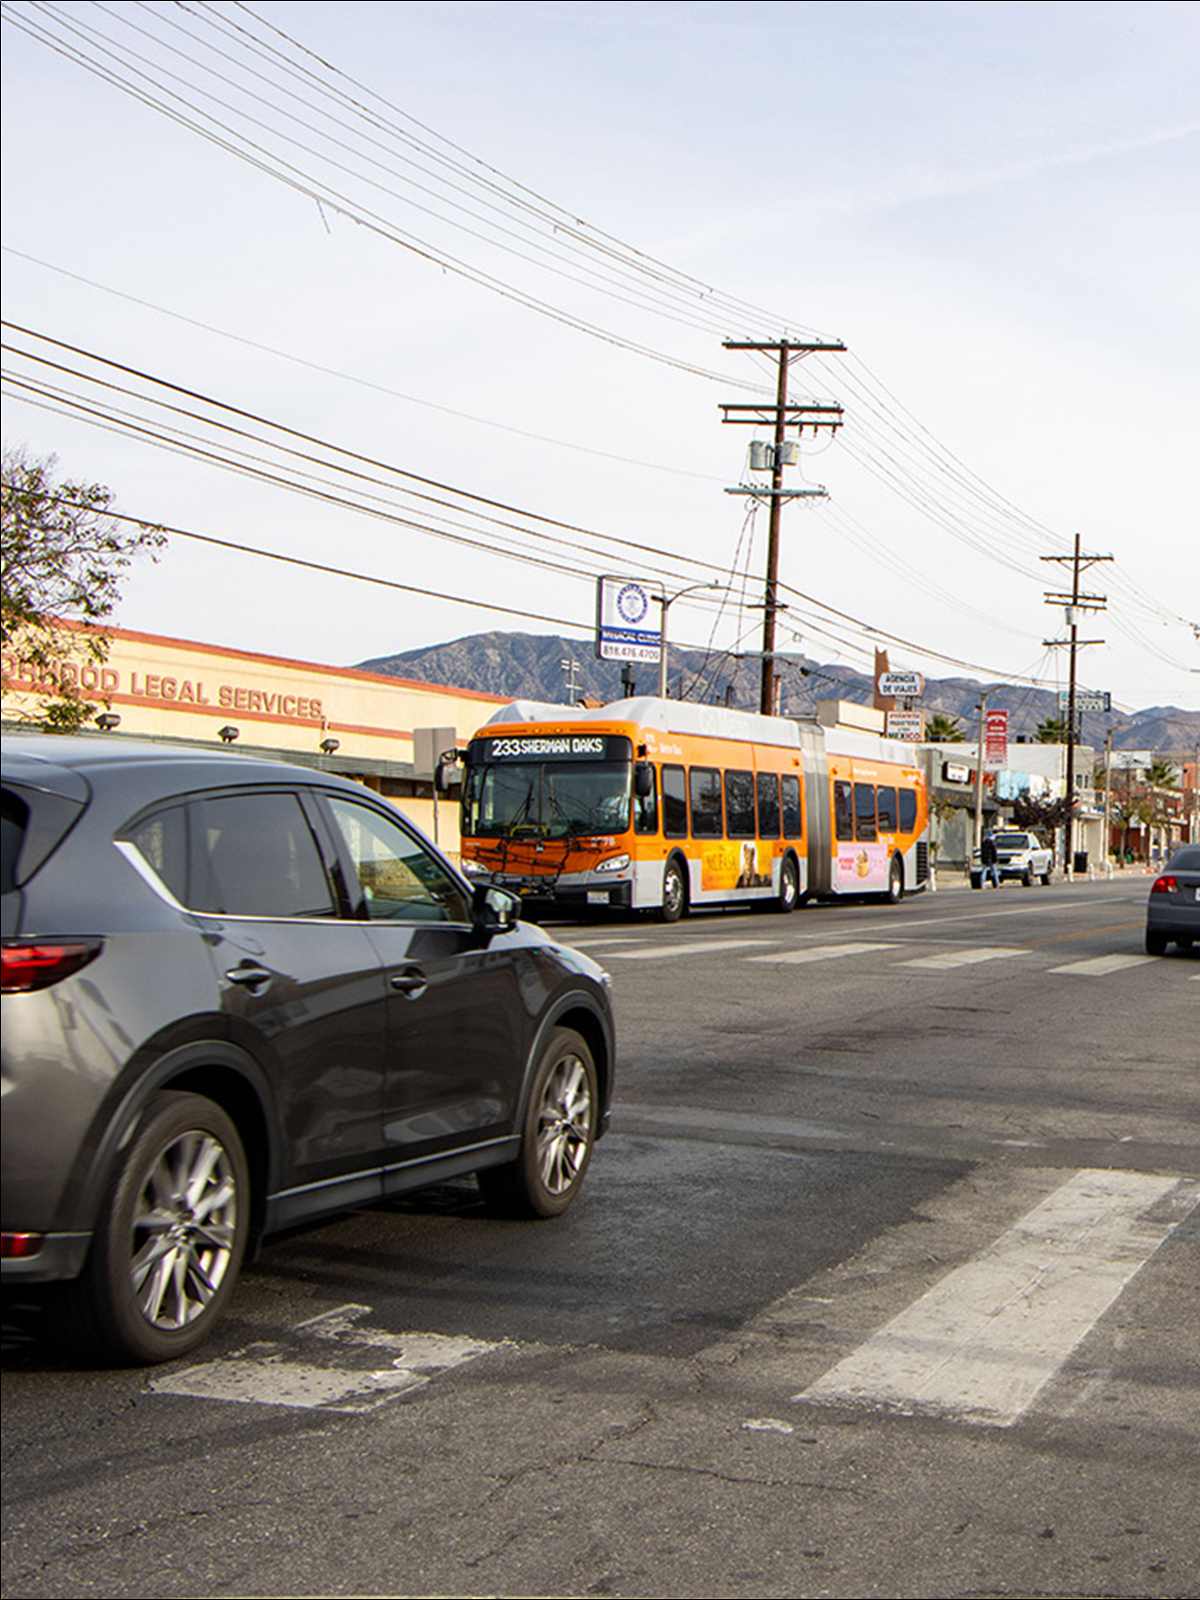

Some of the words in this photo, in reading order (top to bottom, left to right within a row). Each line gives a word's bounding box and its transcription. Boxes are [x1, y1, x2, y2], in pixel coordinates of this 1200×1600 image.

[130, 671, 210, 704] LEGAL
[218, 685, 324, 719] SERVICES
[491, 739, 520, 756] 233
[520, 739, 572, 754] SHERMAN
[574, 738, 603, 753] OAKS
